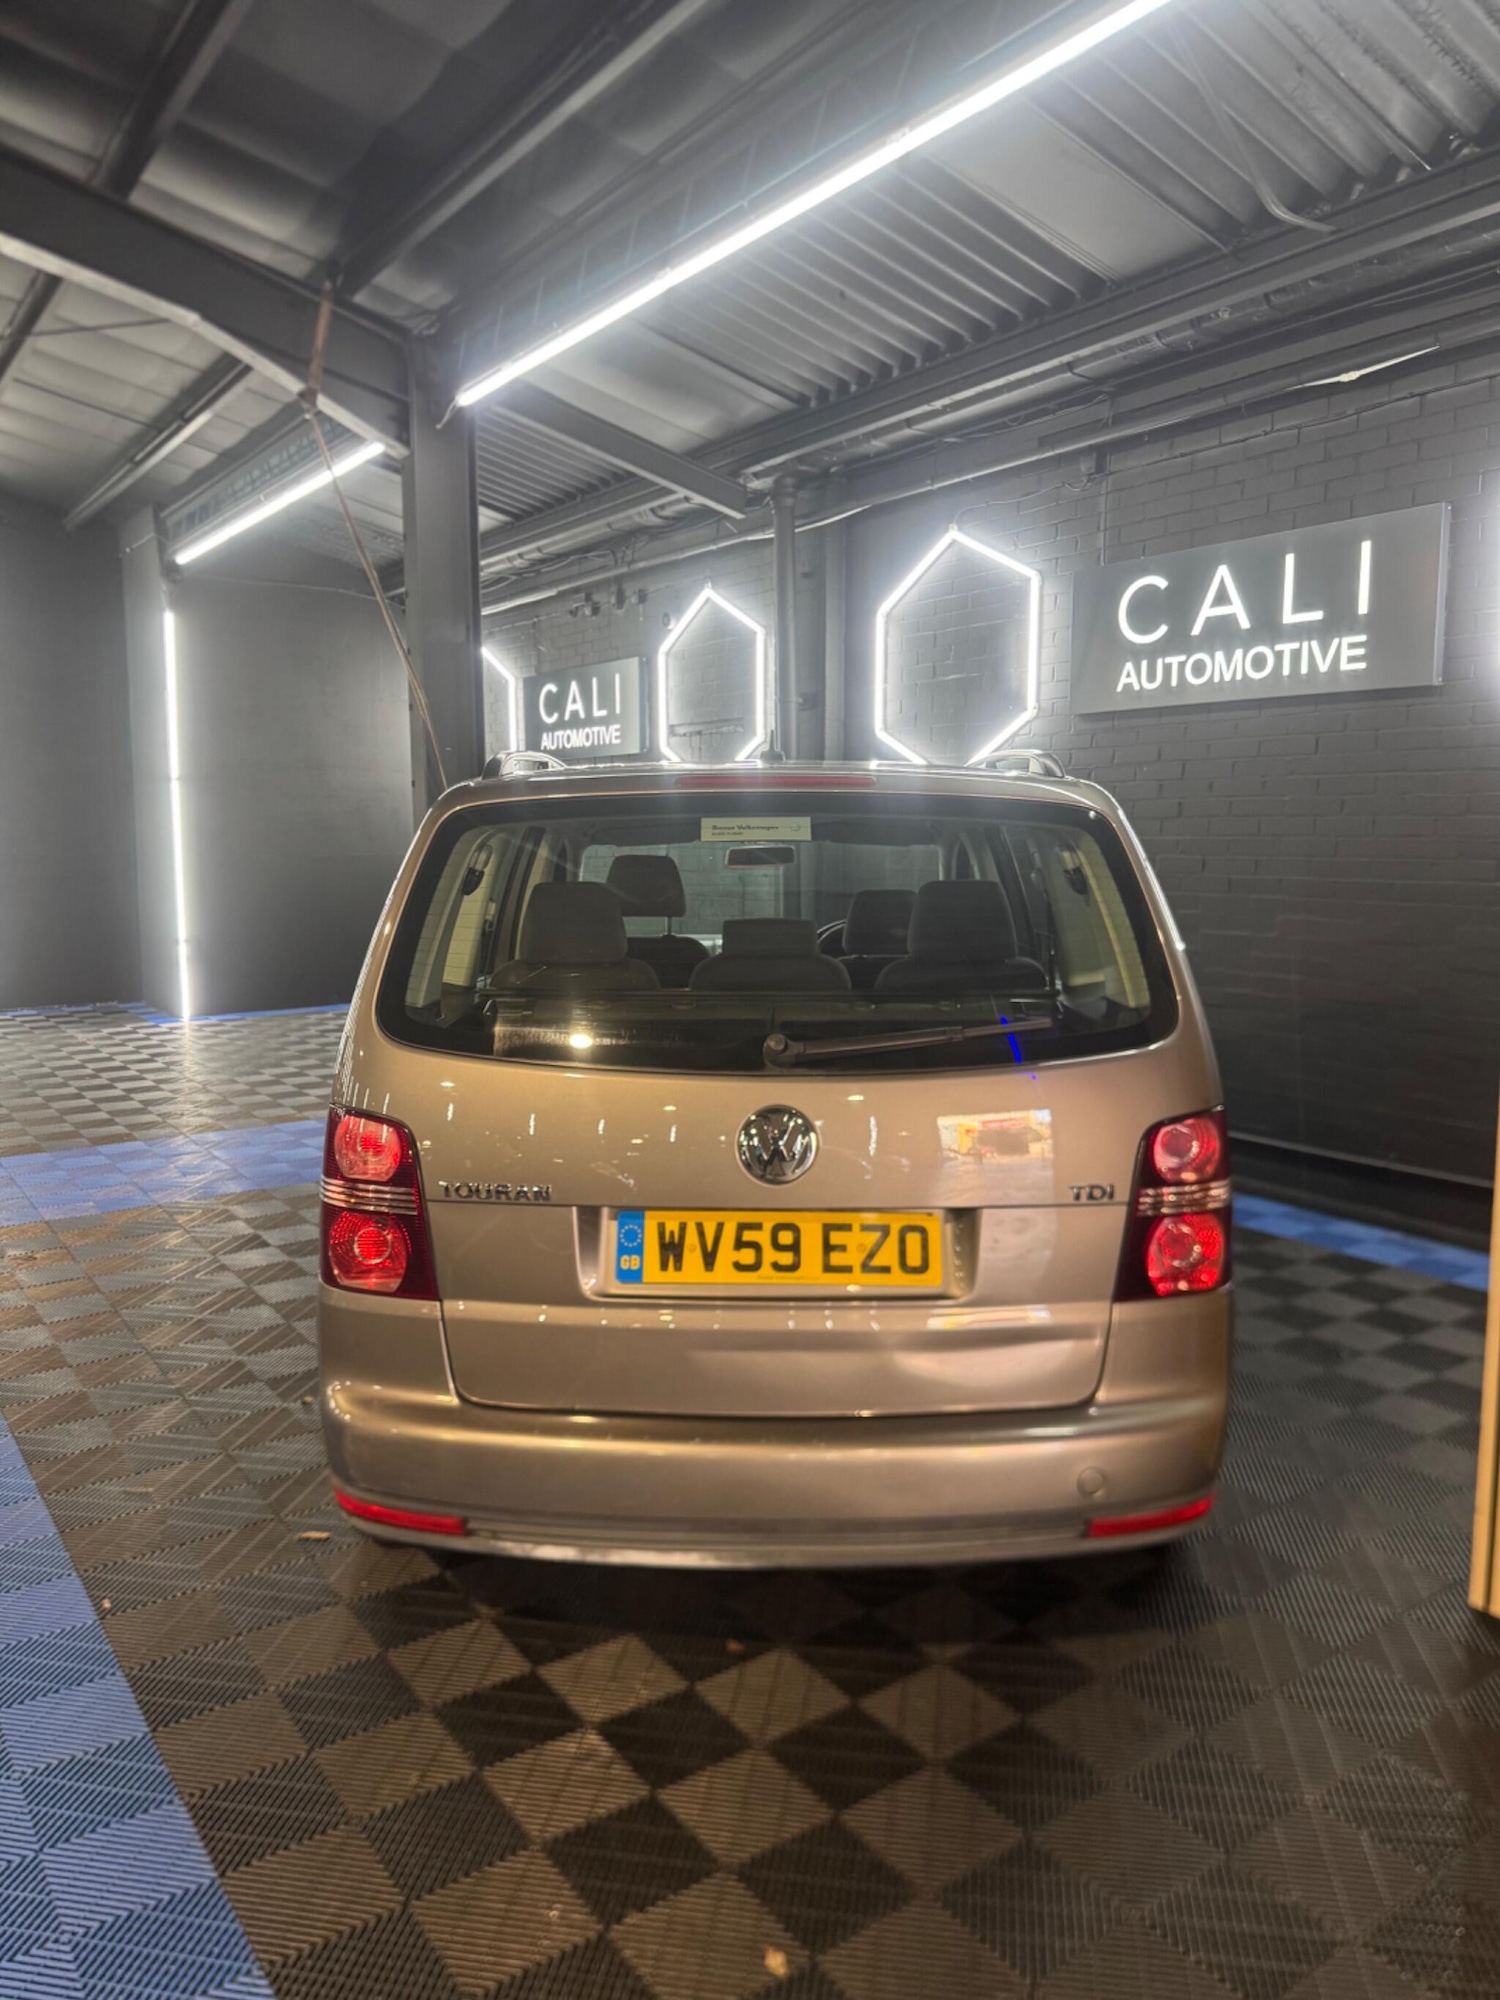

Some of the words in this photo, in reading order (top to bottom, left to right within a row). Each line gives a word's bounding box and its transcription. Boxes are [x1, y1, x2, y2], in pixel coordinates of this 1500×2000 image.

[1118, 540, 1372, 644] CALI
[1116, 634, 1367, 693] AUTOMOTIVE
[539, 673, 621, 724] CALI
[540, 724, 621, 751] AUTOMOTIVE
[438, 1180, 552, 1201] TOURAN
[1068, 1183, 1115, 1202] TDI
[619, 1254, 640, 1271] GB
[656, 1222, 801, 1273] WV59
[821, 1222, 930, 1275] EZO
